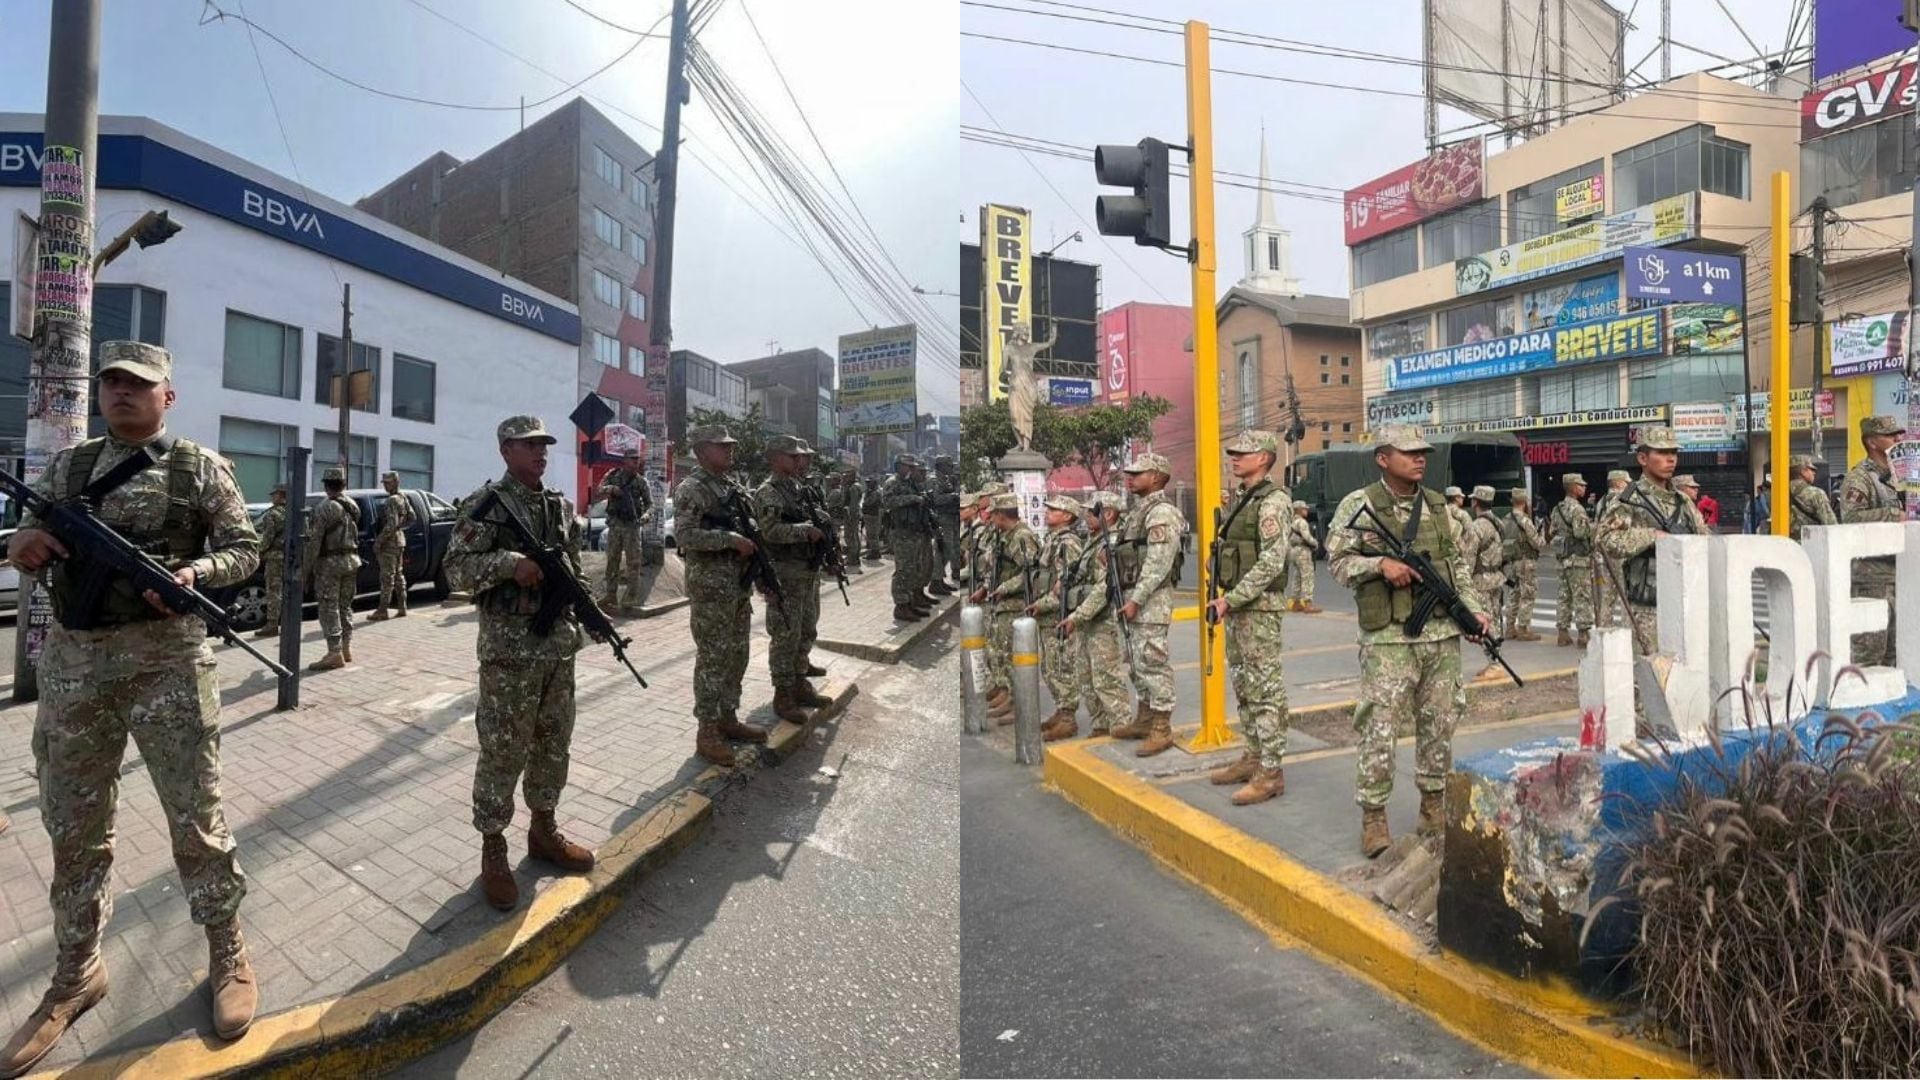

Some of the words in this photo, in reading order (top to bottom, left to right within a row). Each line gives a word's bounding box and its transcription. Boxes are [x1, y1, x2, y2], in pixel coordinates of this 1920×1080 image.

[1815, 70, 1900, 129] GV
[1564, 192, 1586, 206] LOCAL
[1566, 180, 1590, 195] ALQUILA
[243, 189, 325, 239] BBVA
[1351, 196, 1369, 229] 19
[502, 293, 544, 323] BBVA
[1400, 352, 1451, 374] EXAMEN
[1509, 331, 1551, 356] PARA
[1556, 313, 1657, 362] BREVETE
[842, 357, 911, 374] BREVETES
[1834, 365, 1858, 376] RESERVA
[1867, 360, 1883, 371] 991
[1369, 400, 1433, 422] Gynecare
[1441, 424, 1463, 435] Curso
[1466, 422, 1475, 432] de
[1479, 415, 1537, 430] Actualización
[1543, 415, 1564, 426] para
[1568, 411, 1583, 422] los
[1587, 406, 1658, 421] Conductores
[1674, 415, 1727, 427] BREVETES
